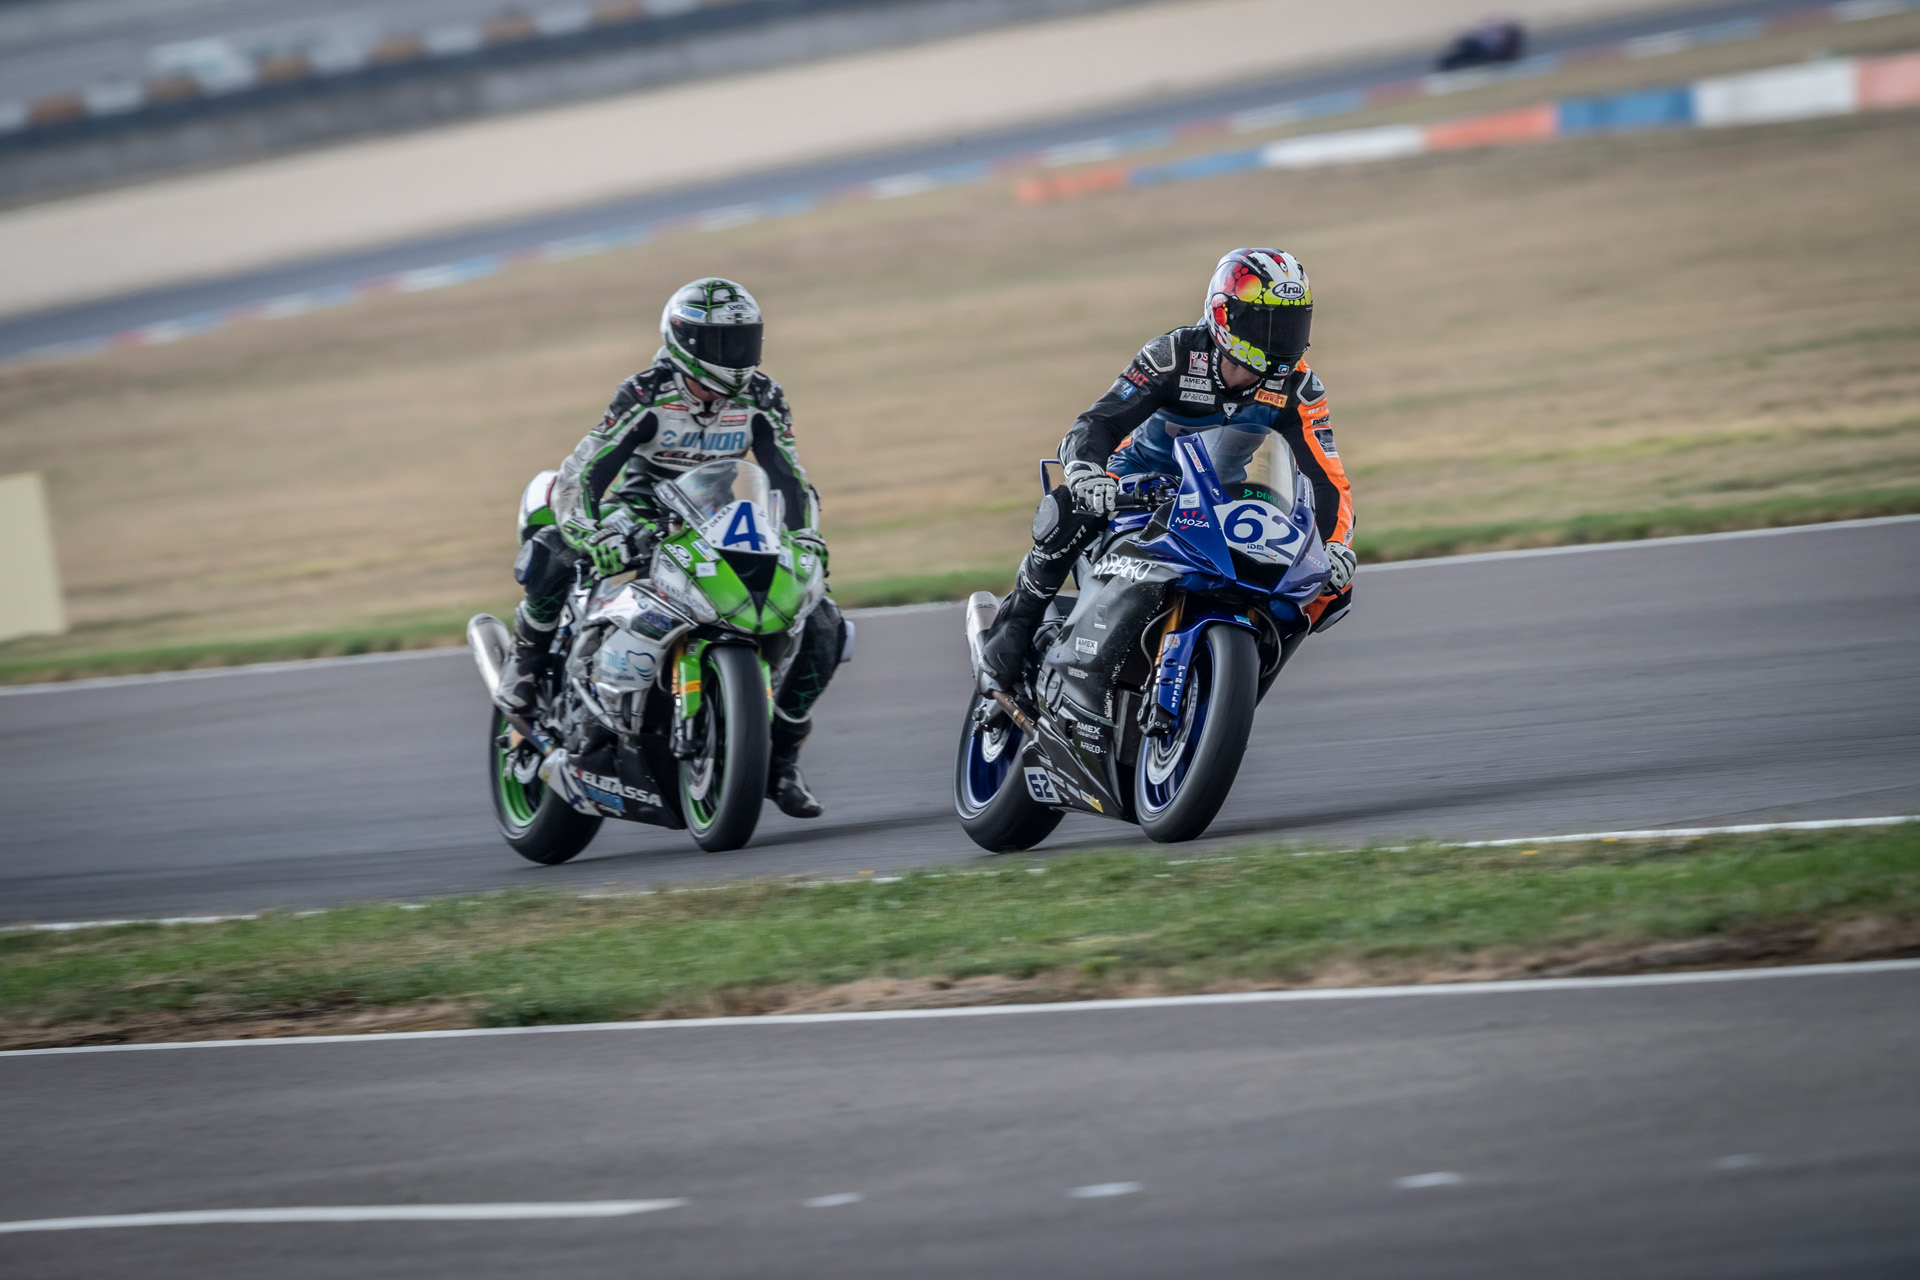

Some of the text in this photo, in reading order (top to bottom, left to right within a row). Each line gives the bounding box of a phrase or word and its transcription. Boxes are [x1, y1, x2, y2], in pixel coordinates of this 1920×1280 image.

[1274, 283, 1302, 296] Arai
[1183, 377, 1207, 386] AMEX
[679, 431, 746, 451] UNIOR
[722, 501, 768, 552] 4
[1174, 516, 1211, 529] MOZA
[1223, 503, 1300, 562] 62
[1077, 638, 1096, 649] AMEX
[1076, 722, 1101, 735] AMEX
[567, 763, 664, 808] KIELBASSA
[1027, 773, 1055, 799] 62
